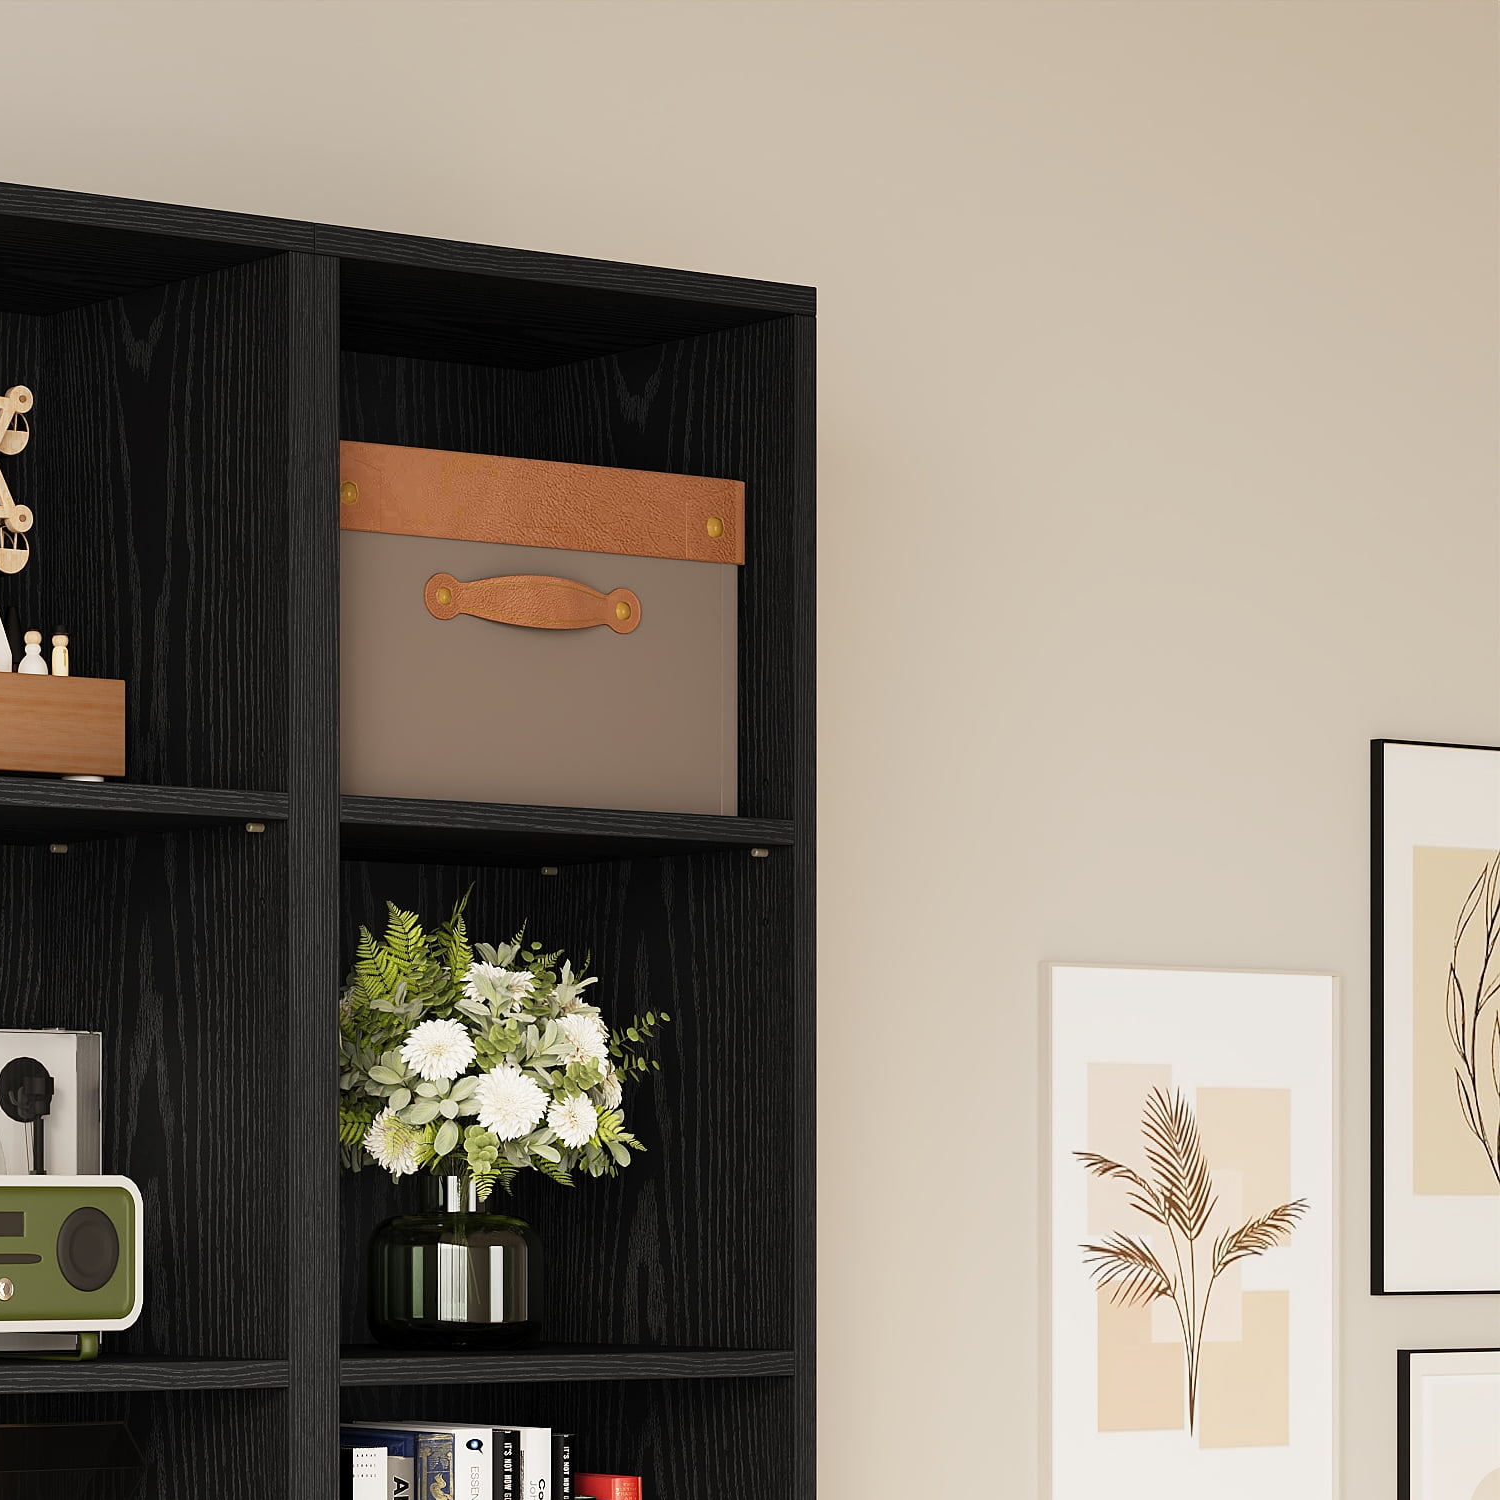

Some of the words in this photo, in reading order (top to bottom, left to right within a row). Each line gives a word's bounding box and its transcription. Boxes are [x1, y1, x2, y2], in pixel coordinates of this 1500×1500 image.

[504, 1442, 512, 1456] IT'S
[504, 1459, 512, 1472] NOT
[504, 1474, 512, 1491] HOW
